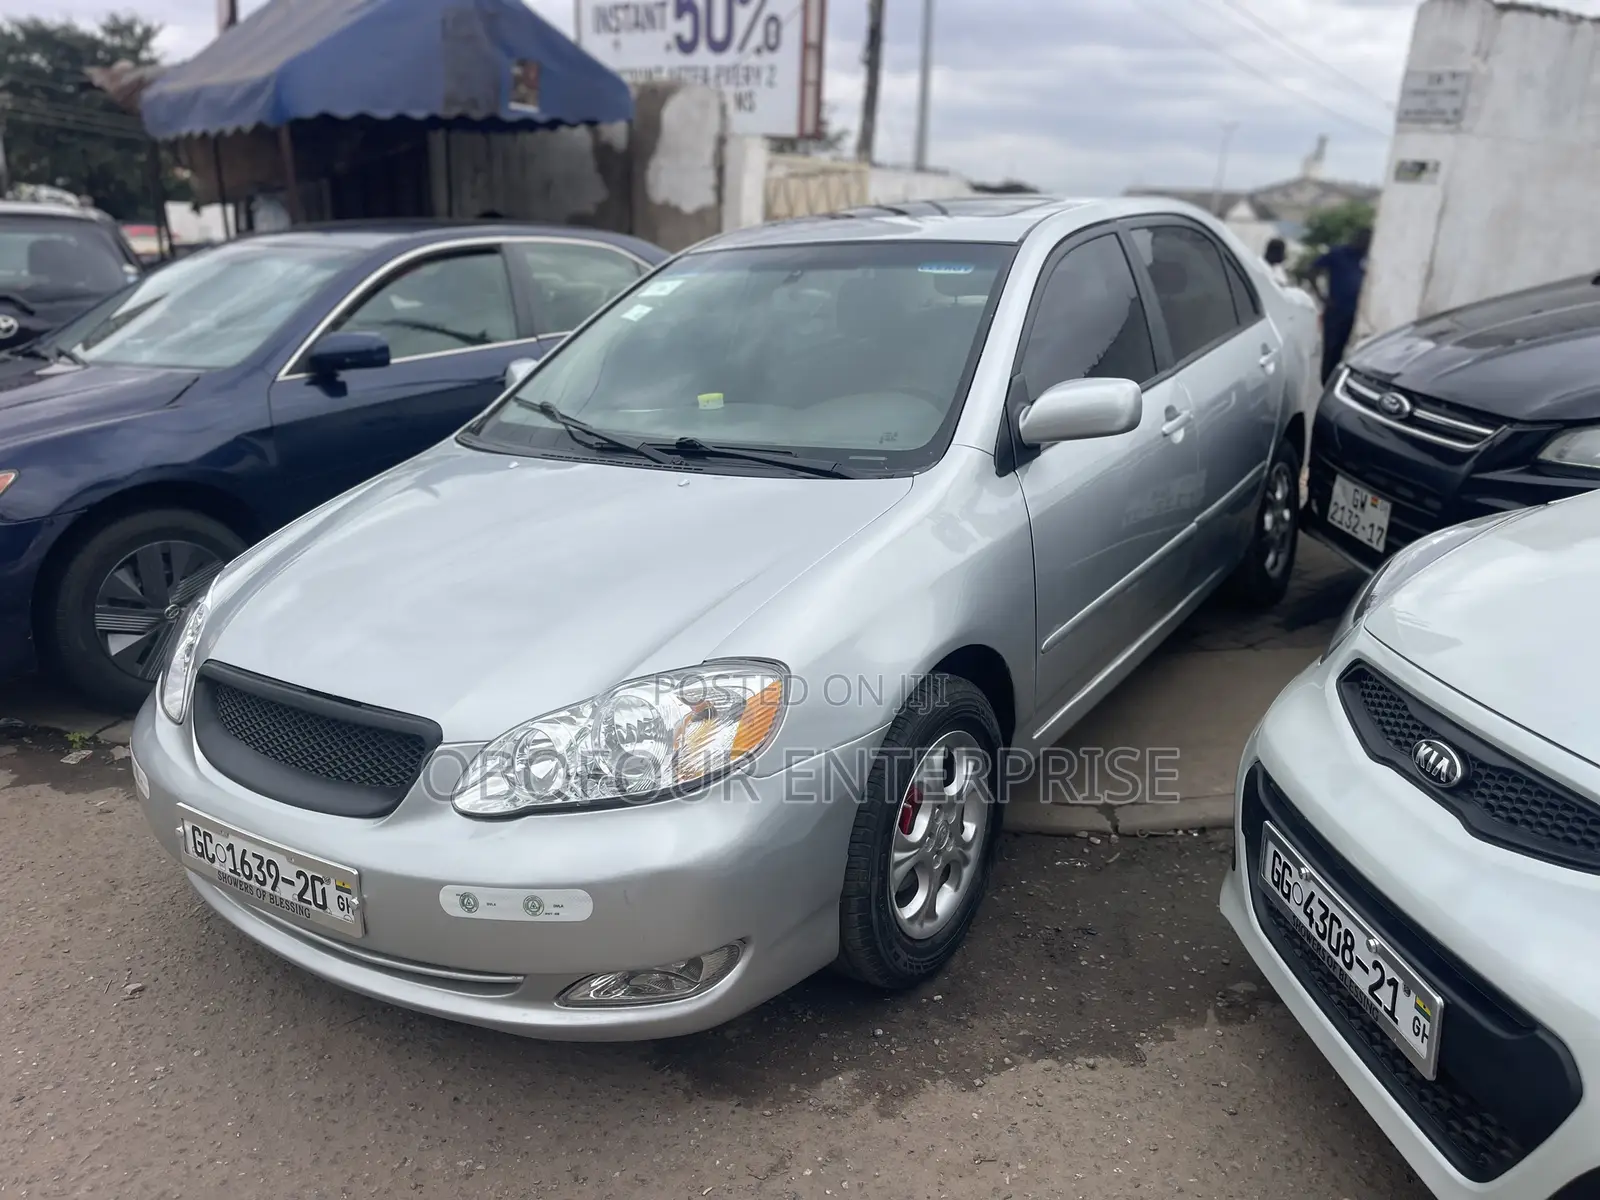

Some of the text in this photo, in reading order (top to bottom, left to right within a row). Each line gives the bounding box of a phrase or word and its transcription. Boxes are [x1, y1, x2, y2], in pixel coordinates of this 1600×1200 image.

[593, 2, 667, 34] INSTANT
[765, 64, 778, 88] 2
[1352, 488, 1368, 513] GW
[1330, 501, 1384, 547] 2132-17
[1414, 742, 1449, 783] KIA
[191, 825, 328, 911] GC 1639-20
[217, 870, 312, 919] SHOWERS OF BLESSING
[1271, 849, 1399, 1026] GG 4308-21
[1291, 914, 1380, 1022] SHOWERS OF BLESSING
